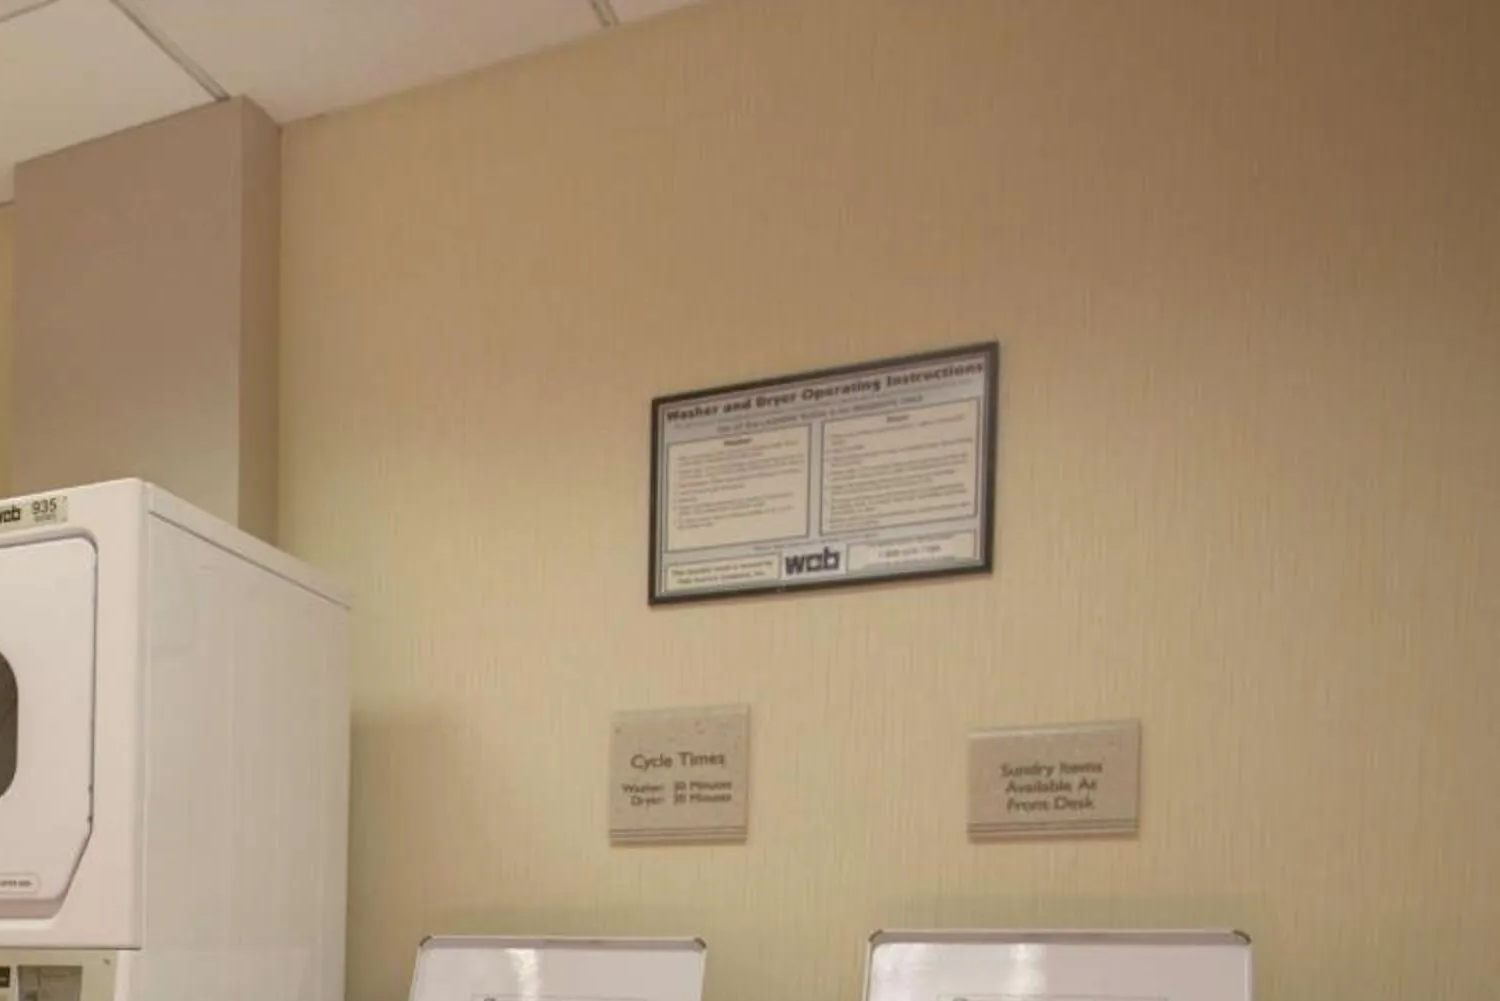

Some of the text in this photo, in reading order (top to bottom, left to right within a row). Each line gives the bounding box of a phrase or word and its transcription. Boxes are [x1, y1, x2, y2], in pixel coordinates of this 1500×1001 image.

[666, 404, 719, 421] Washer
[723, 399, 752, 414] and
[755, 392, 798, 410] Dryer
[801, 377, 882, 401] Operating
[886, 363, 984, 387] Instructions
[630, 751, 726, 772] Cycle Times
[1000, 761, 1056, 779] Sundry
[1004, 779, 1073, 795] Available
[1006, 795, 1095, 814] Front Desk
